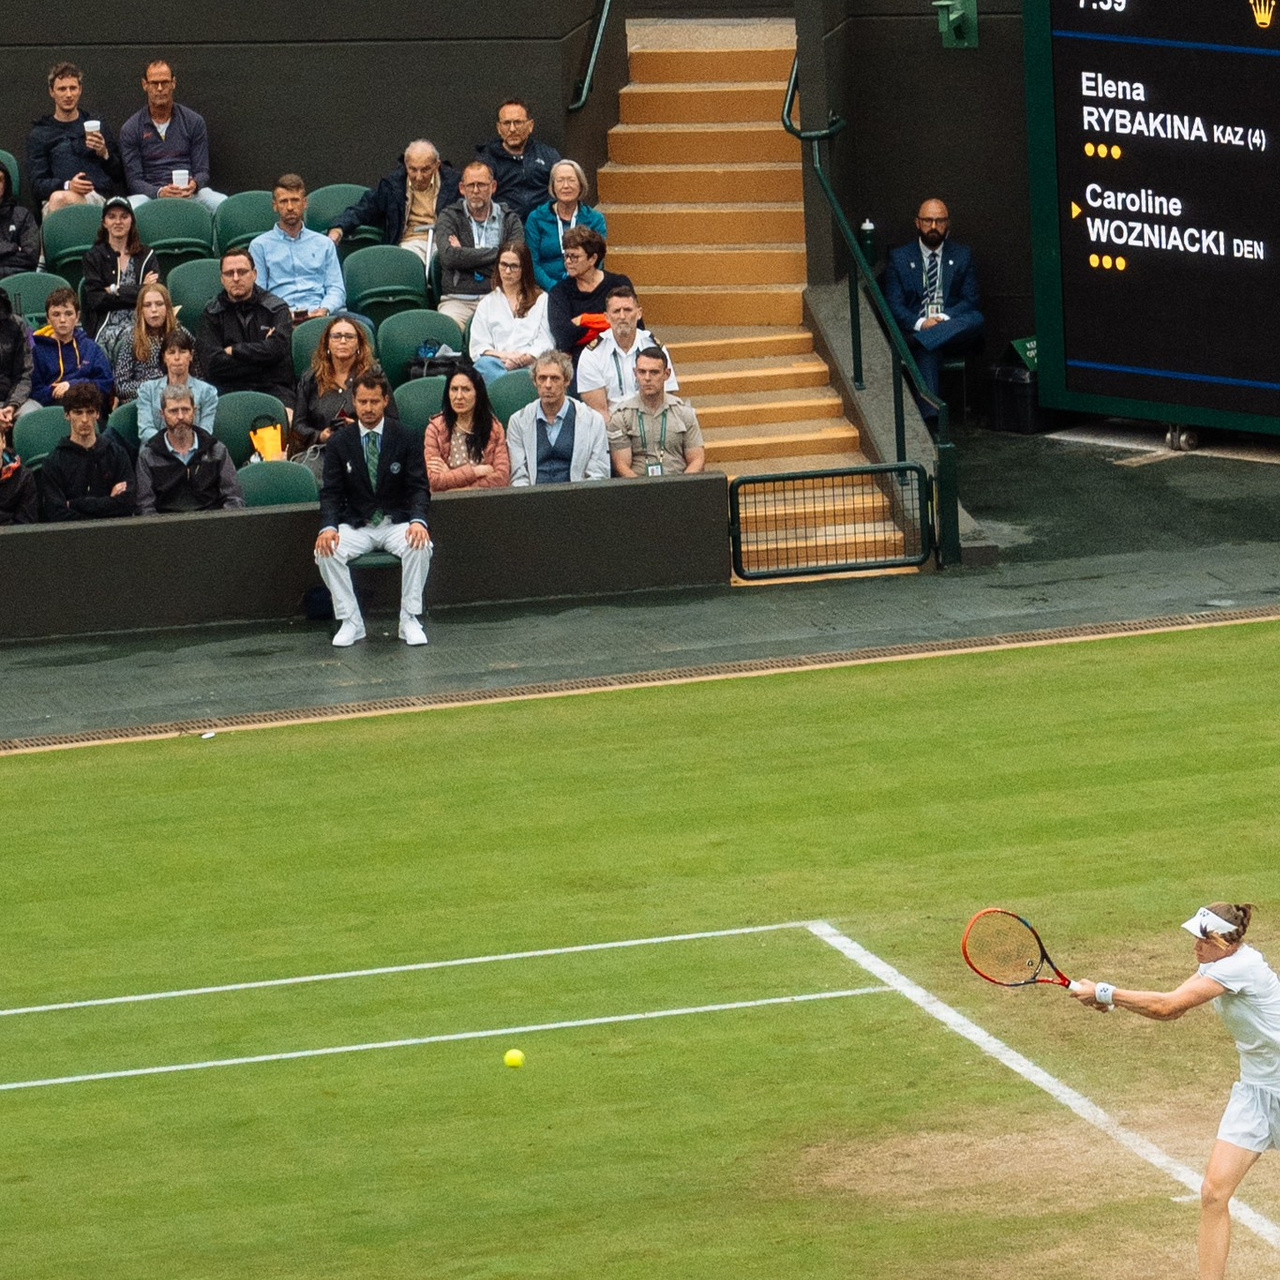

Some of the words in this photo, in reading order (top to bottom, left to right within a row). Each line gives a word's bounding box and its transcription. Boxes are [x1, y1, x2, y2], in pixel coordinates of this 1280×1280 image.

[1082, 72, 1145, 101] Elena
[1083, 106, 1208, 142] RYBAKINA
[1213, 124, 1245, 146] KAZ
[1247, 128, 1267, 152] (4)
[1086, 184, 1182, 216] Caroline
[1086, 218, 1225, 256] WOZNIACKI
[1232, 238, 1264, 260] DEN
